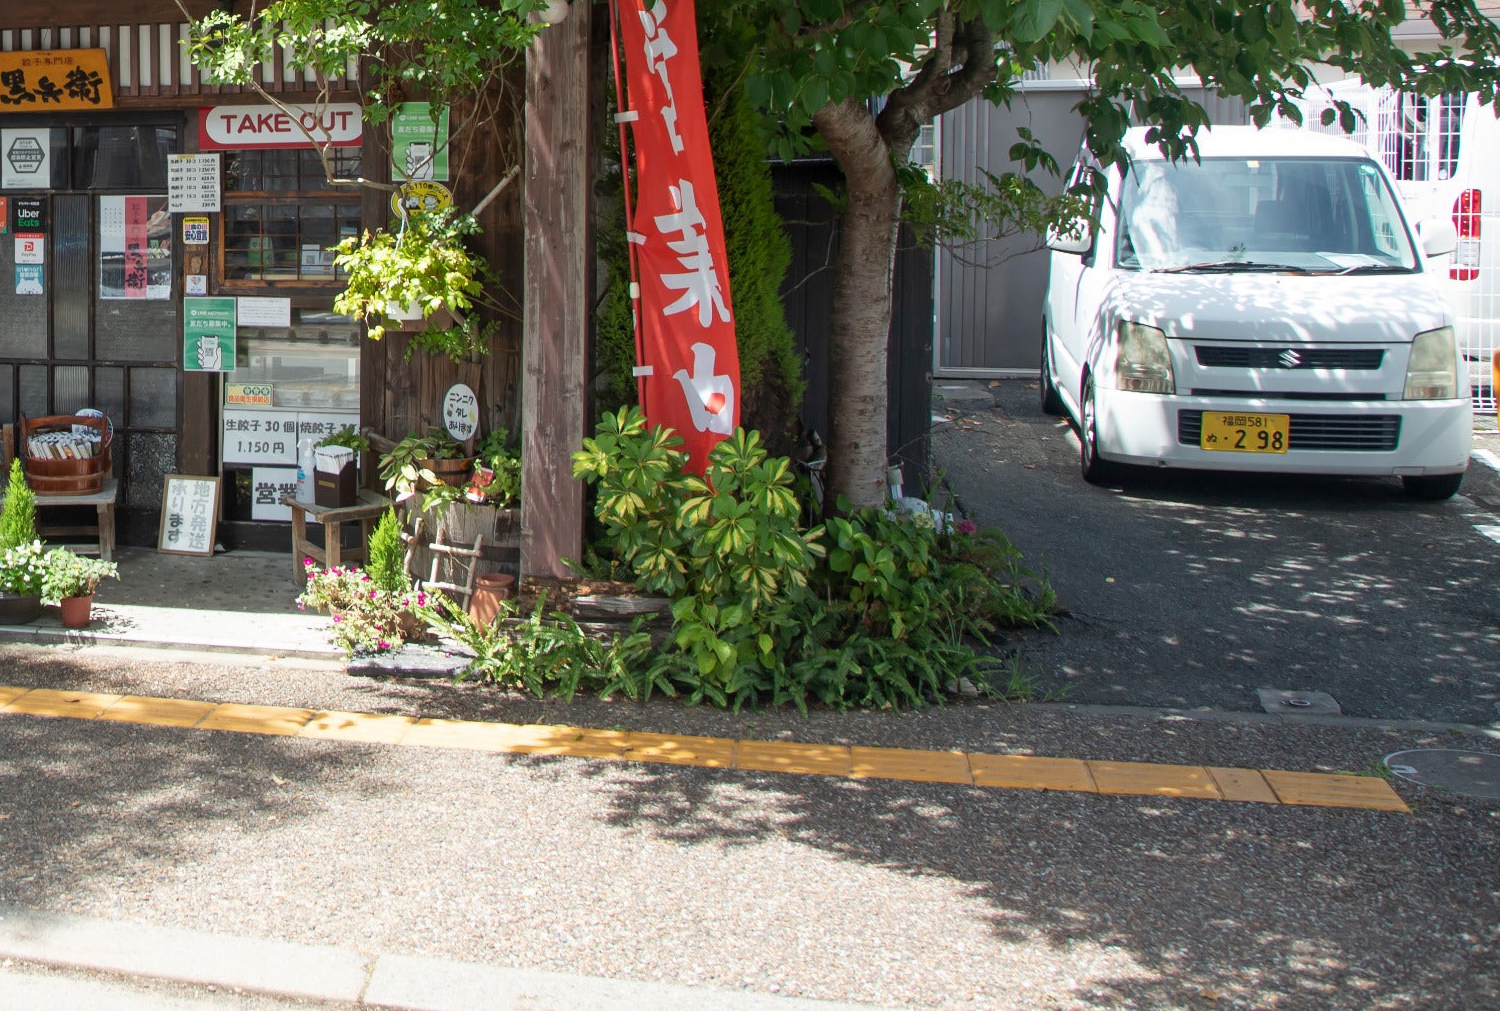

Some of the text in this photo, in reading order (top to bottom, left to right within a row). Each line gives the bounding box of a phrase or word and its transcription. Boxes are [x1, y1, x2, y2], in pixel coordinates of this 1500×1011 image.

[0, 65, 104, 105] 黒兵衛
[220, 111, 353, 134] TAKE OUT
[18, 209, 40, 218] Uber
[18, 218, 40, 227] Eats
[449, 392, 474, 405] ニンニク
[455, 408, 468, 418] タレ
[448, 420, 473, 436] あります
[1206, 433, 1217, 443] ぬ
[167, 479, 188, 544] 承ります
[188, 480, 211, 550] 地方発送
